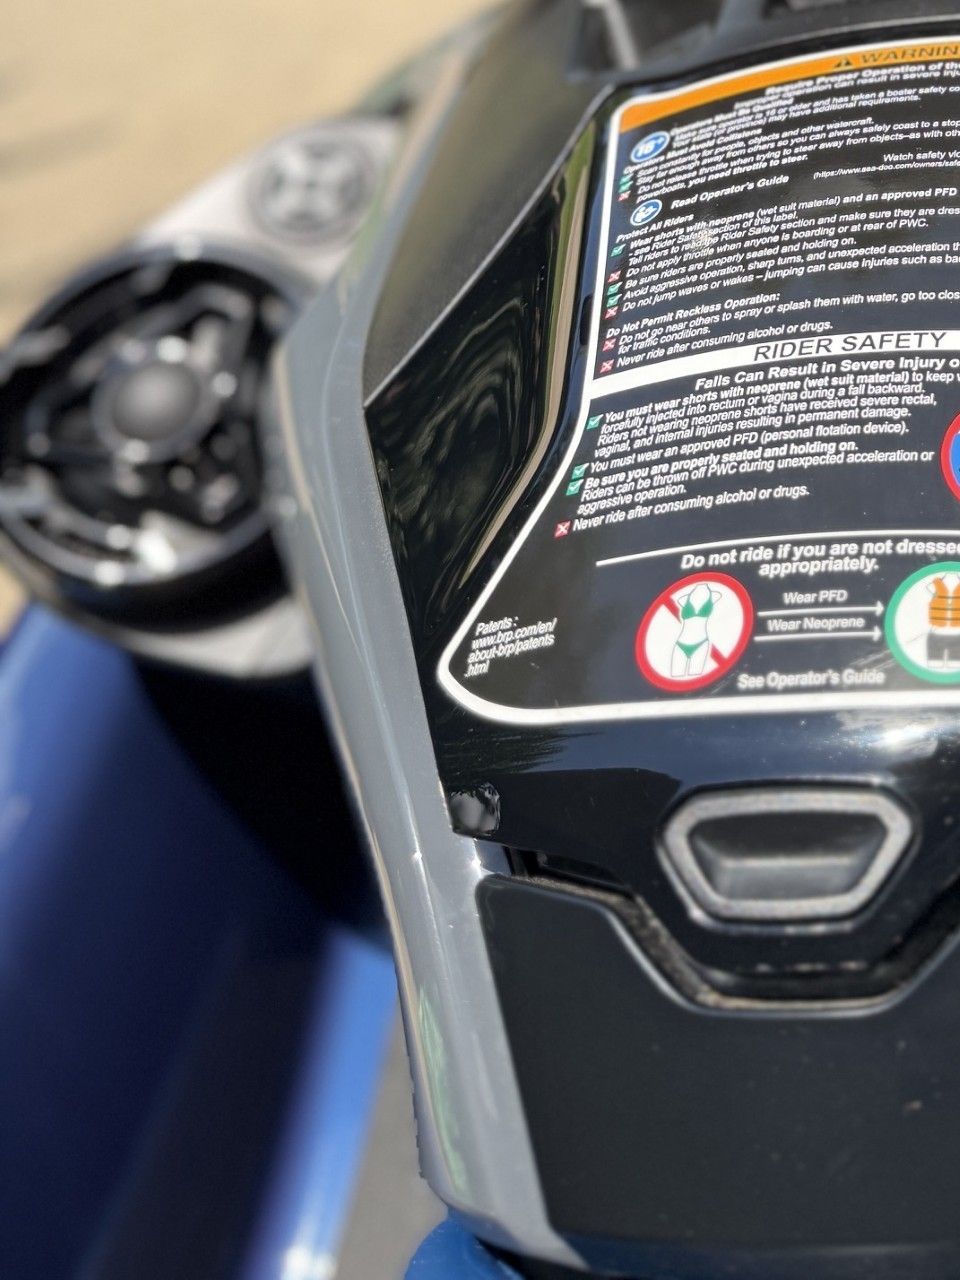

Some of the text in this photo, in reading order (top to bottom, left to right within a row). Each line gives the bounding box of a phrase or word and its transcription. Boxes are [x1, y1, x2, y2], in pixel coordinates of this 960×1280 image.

[883, 151, 914, 162] Watch
[915, 150, 946, 160] safety
[670, 174, 789, 209] Read Operator's Guide
[622, 284, 649, 300] Avoid
[648, 274, 698, 293] aggressive
[699, 264, 746, 281] operation,
[747, 259, 775, 271] sharp
[776, 254, 805, 265] turns,
[805, 249, 826, 261] and
[827, 244, 887, 259] unexpected
[887, 241, 950, 254] acceleration
[605, 292, 780, 339] Do Not Permit Reckless Operation:
[616, 321, 833, 368] Never ride after consuming alcohol or drugs.
[754, 331, 947, 362] RIDER SAFETY
[694, 374, 731, 391] Falls
[734, 370, 764, 383] Can
[767, 362, 818, 379] Result
[820, 361, 836, 373] in
[839, 359, 895, 372] Severe
[898, 356, 945, 371] Injury
[605, 410, 624, 423] You
[624, 402, 653, 421] must
[654, 398, 680, 412] wear
[681, 390, 718, 406] shorts
[719, 385, 744, 399] with
[745, 380, 801, 395] neoprene
[802, 375, 829, 390] (wet
[830, 373, 855, 387] suit
[855, 370, 909, 386] material)
[911, 371, 924, 382] to
[925, 370, 955, 384] keep
[590, 420, 909, 473] You must wear an approved PFD (personal flotation device).
[572, 484, 810, 531] Never ride after consuming alcohol or drugs.
[680, 553, 705, 567] Do
[707, 548, 737, 565] not
[739, 545, 774, 562] ride
[776, 543, 790, 559] if
[792, 544, 826, 558] you
[829, 542, 859, 555] are
[861, 539, 893, 554] not
[758, 556, 880, 578] appropriately.
[783, 589, 848, 604] Wear PFD
[471, 617, 558, 650] www.brp.com/en/
[475, 617, 513, 636] Patents
[767, 616, 865, 632] Wear Neoprene
[467, 633, 556, 663] about-brp/patents
[464, 660, 490, 678] .html
[736, 667, 886, 686] See Operator's Guide
